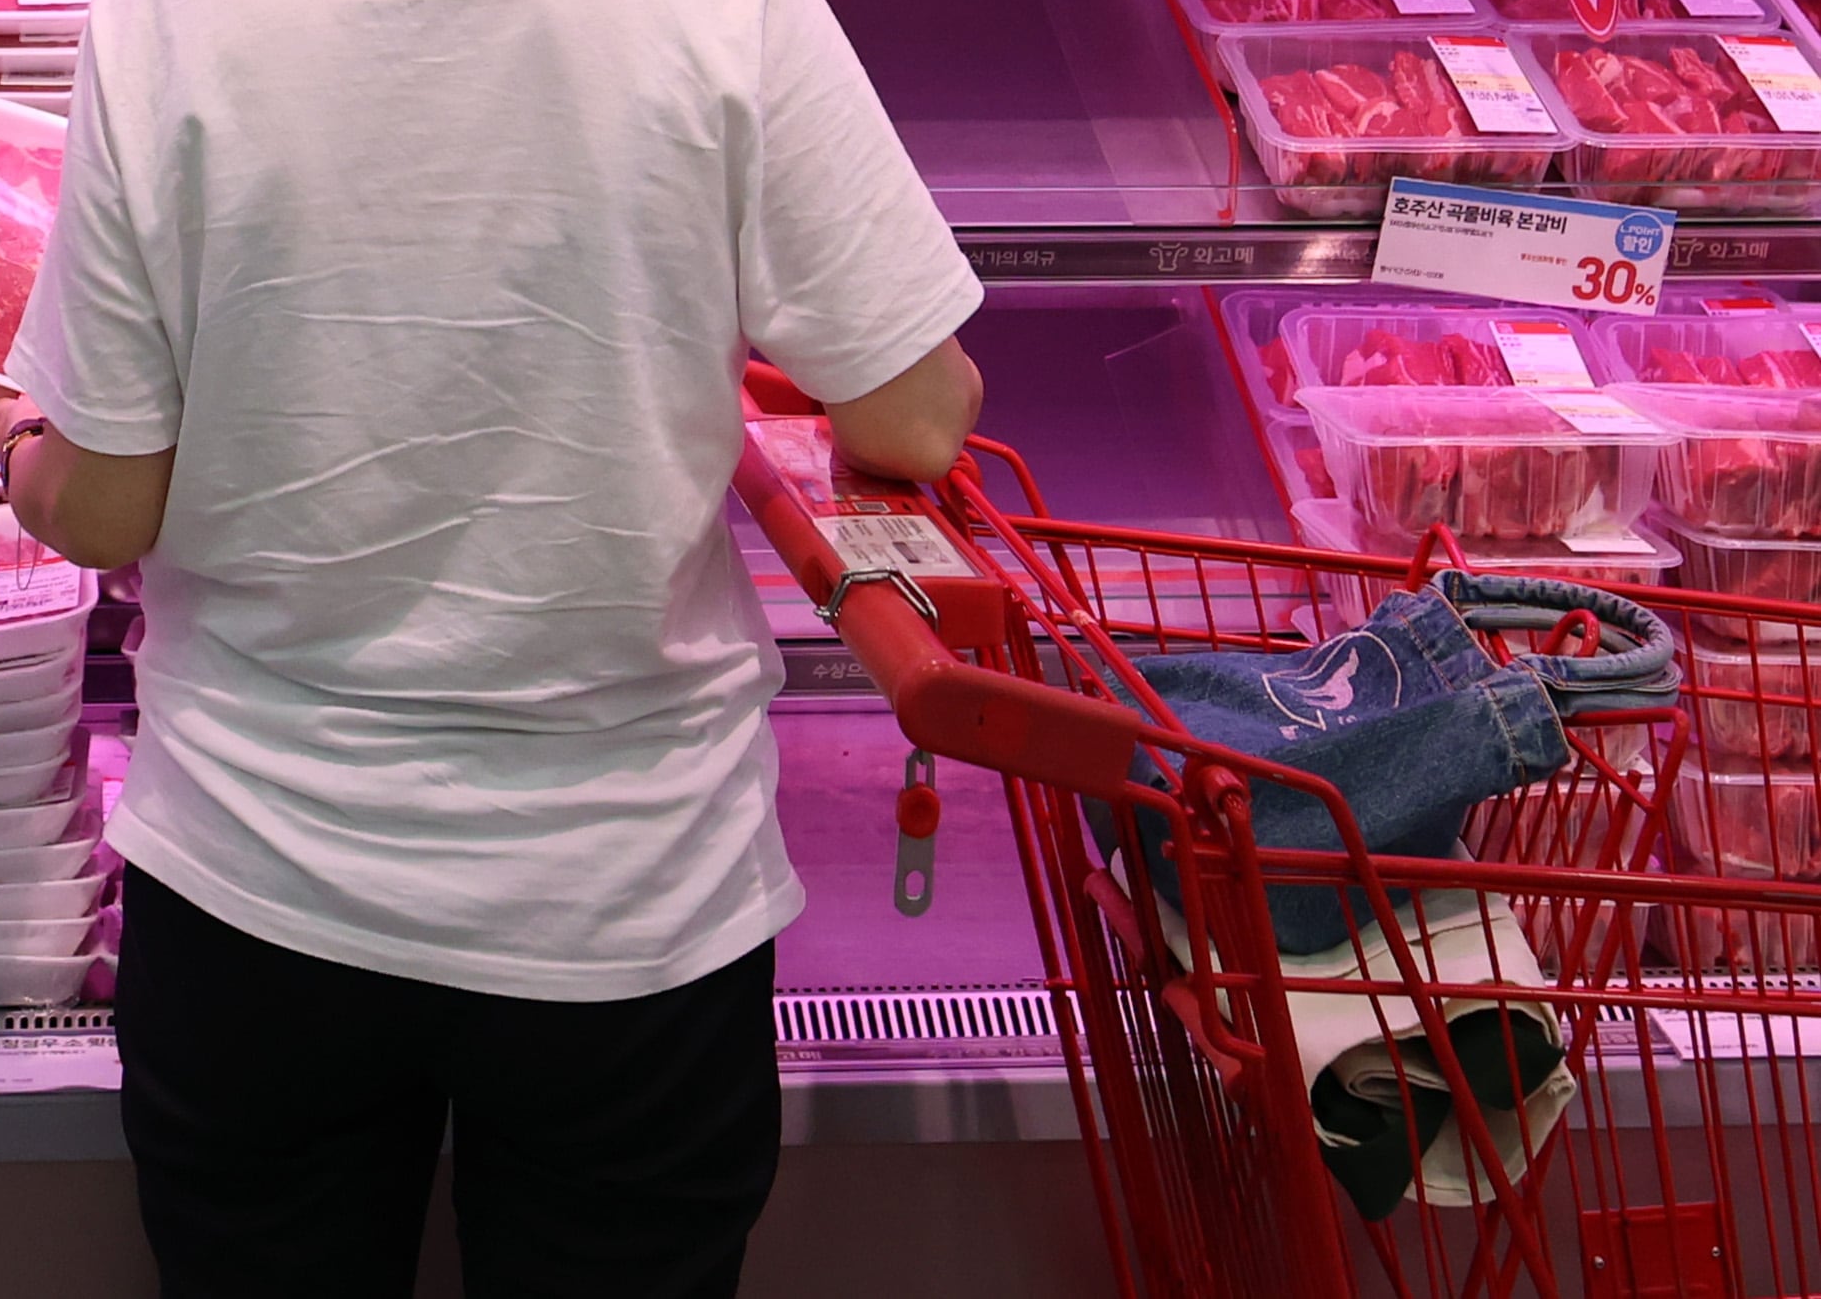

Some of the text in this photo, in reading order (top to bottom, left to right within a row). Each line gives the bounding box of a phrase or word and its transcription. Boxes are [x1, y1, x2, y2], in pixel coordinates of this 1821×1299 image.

[1391, 197, 1444, 219] 호주산
[1446, 202, 1515, 228] 곡물비육
[1516, 210, 1568, 234] 본갈비
[1622, 236, 1654, 254] 할인
[1706, 241, 1770, 258] 와고메
[963, 250, 1056, 267] 식가의 와규
[1192, 246, 1255, 264] 와고메
[1572, 255, 1656, 307] 30%
[812, 663, 870, 679] 수상으
